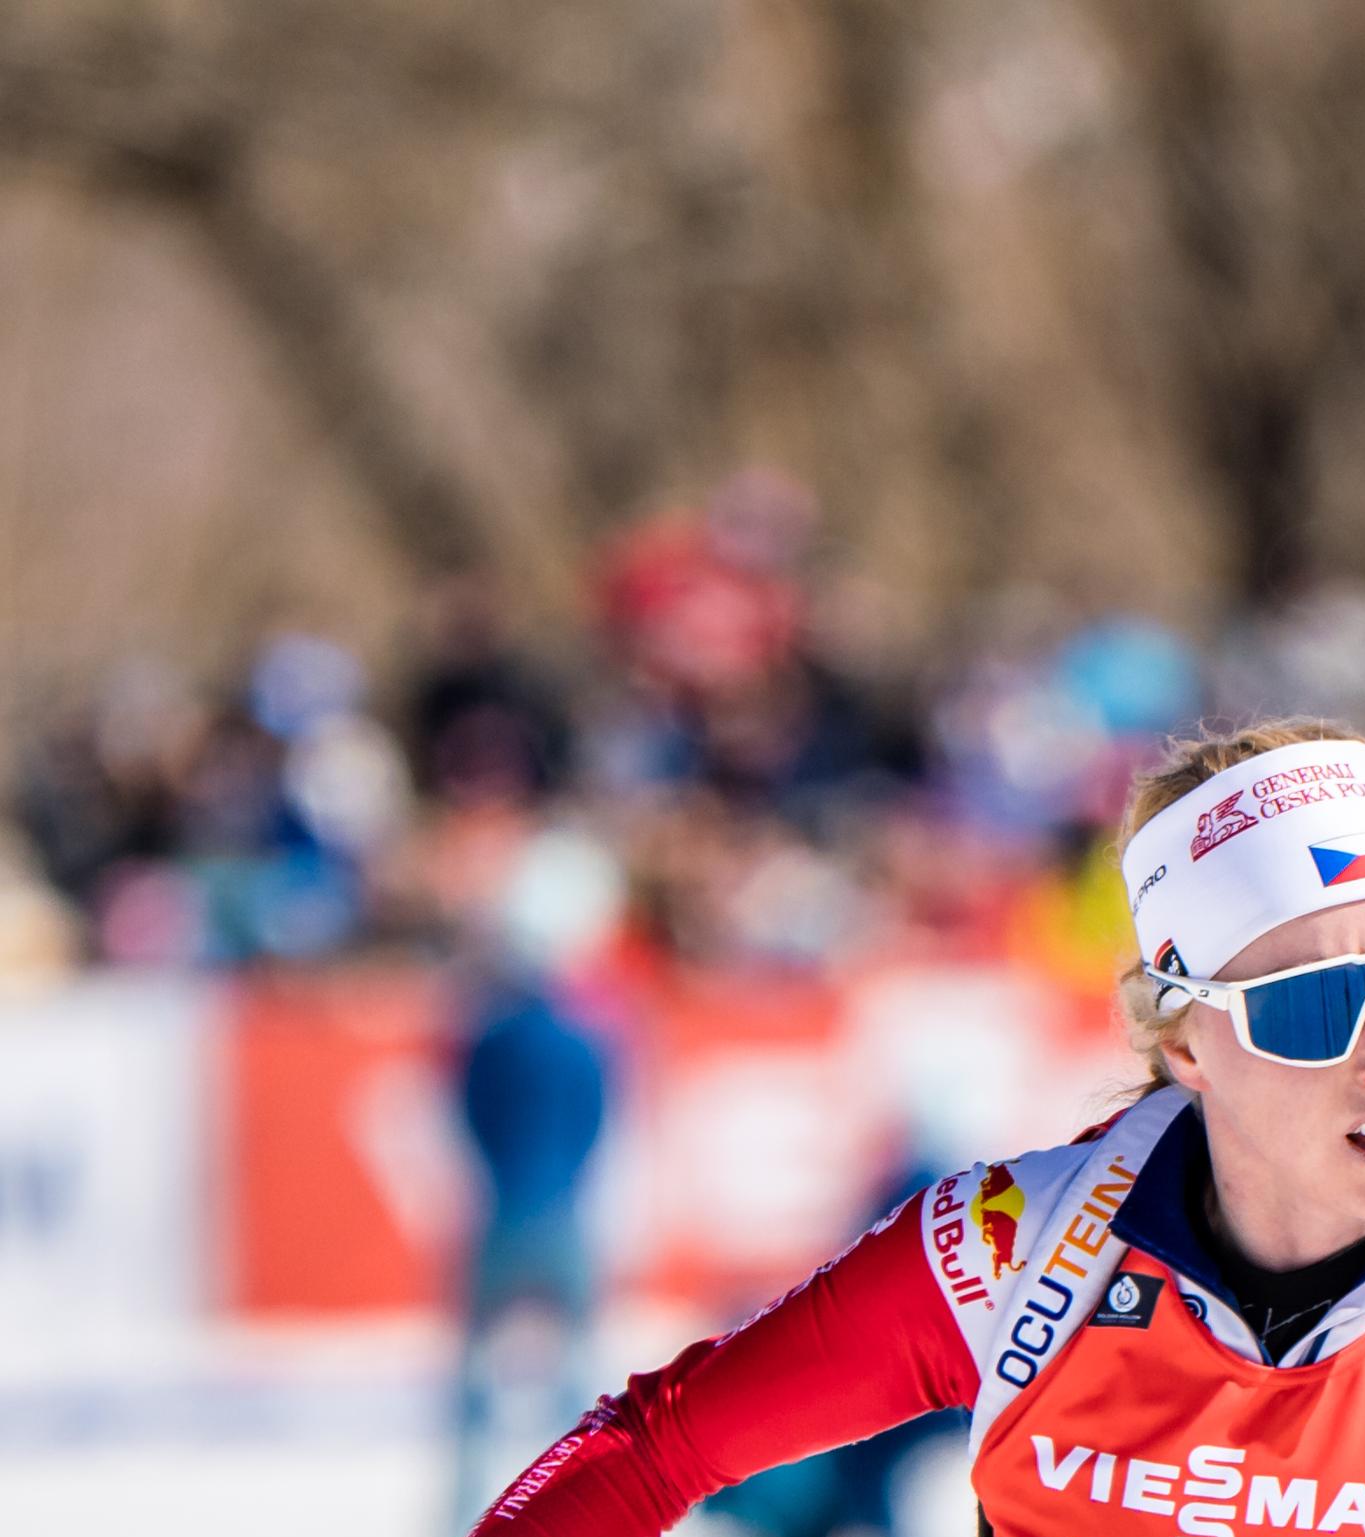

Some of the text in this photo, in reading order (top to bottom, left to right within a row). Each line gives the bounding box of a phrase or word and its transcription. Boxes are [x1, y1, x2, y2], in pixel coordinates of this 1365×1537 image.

[1252, 763, 1355, 799] GENERALI
[1259, 782, 1334, 820] ČESKÁ
[932, 1173, 989, 1307] ed Bull
[996, 1162, 1138, 1390] OCUTEIN
[495, 1436, 582, 1521] GENERALI
